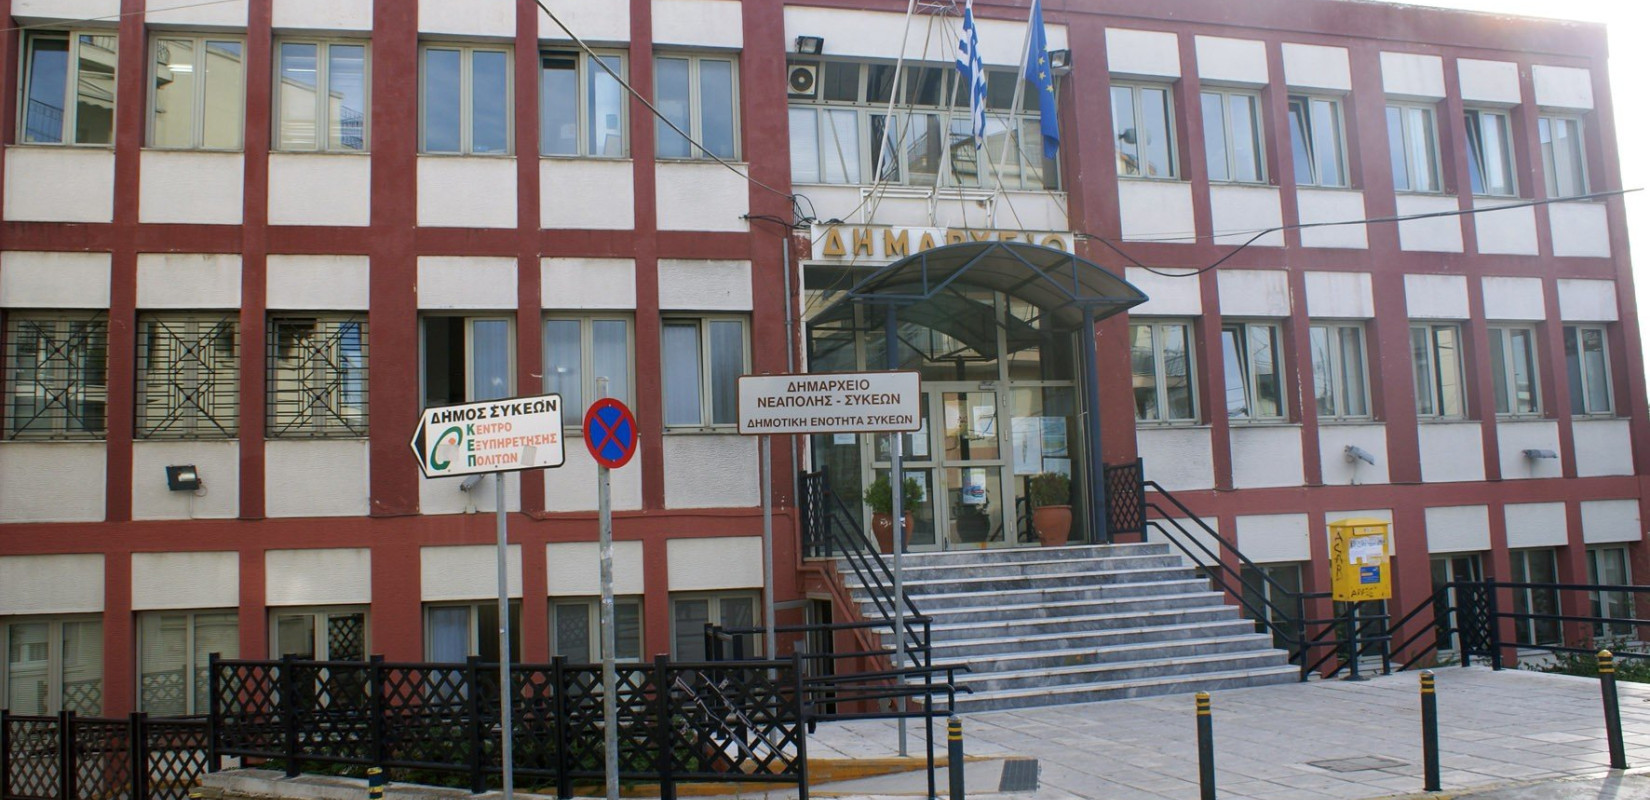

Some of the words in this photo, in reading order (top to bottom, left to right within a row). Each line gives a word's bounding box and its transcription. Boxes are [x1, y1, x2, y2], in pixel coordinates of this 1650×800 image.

[787, 379, 870, 393] ΔΗΜΑΡΧΕΙΟ
[757, 395, 833, 408] ΝΕΑΠΟΛΗΣ
[844, 393, 901, 406] ΣΥΚΕΩΝ
[430, 407, 487, 424] ΔΗΜΟΣ
[490, 399, 557, 418] ΣΥΚΕΩΝ
[466, 422, 512, 436] ΚΕΝΤΡΟ
[747, 417, 807, 428] ΔΗΜΟΤΙΚΗ
[810, 416, 864, 427] ΕΝΟΤΗΤΑ
[867, 415, 913, 425] ΣΥΚΕΩΝ
[467, 433, 557, 451] ΕΞΥΠΗΡΕΤΗΣΗΣ
[467, 452, 518, 467] ΠΟΛΙΤΩΝ
